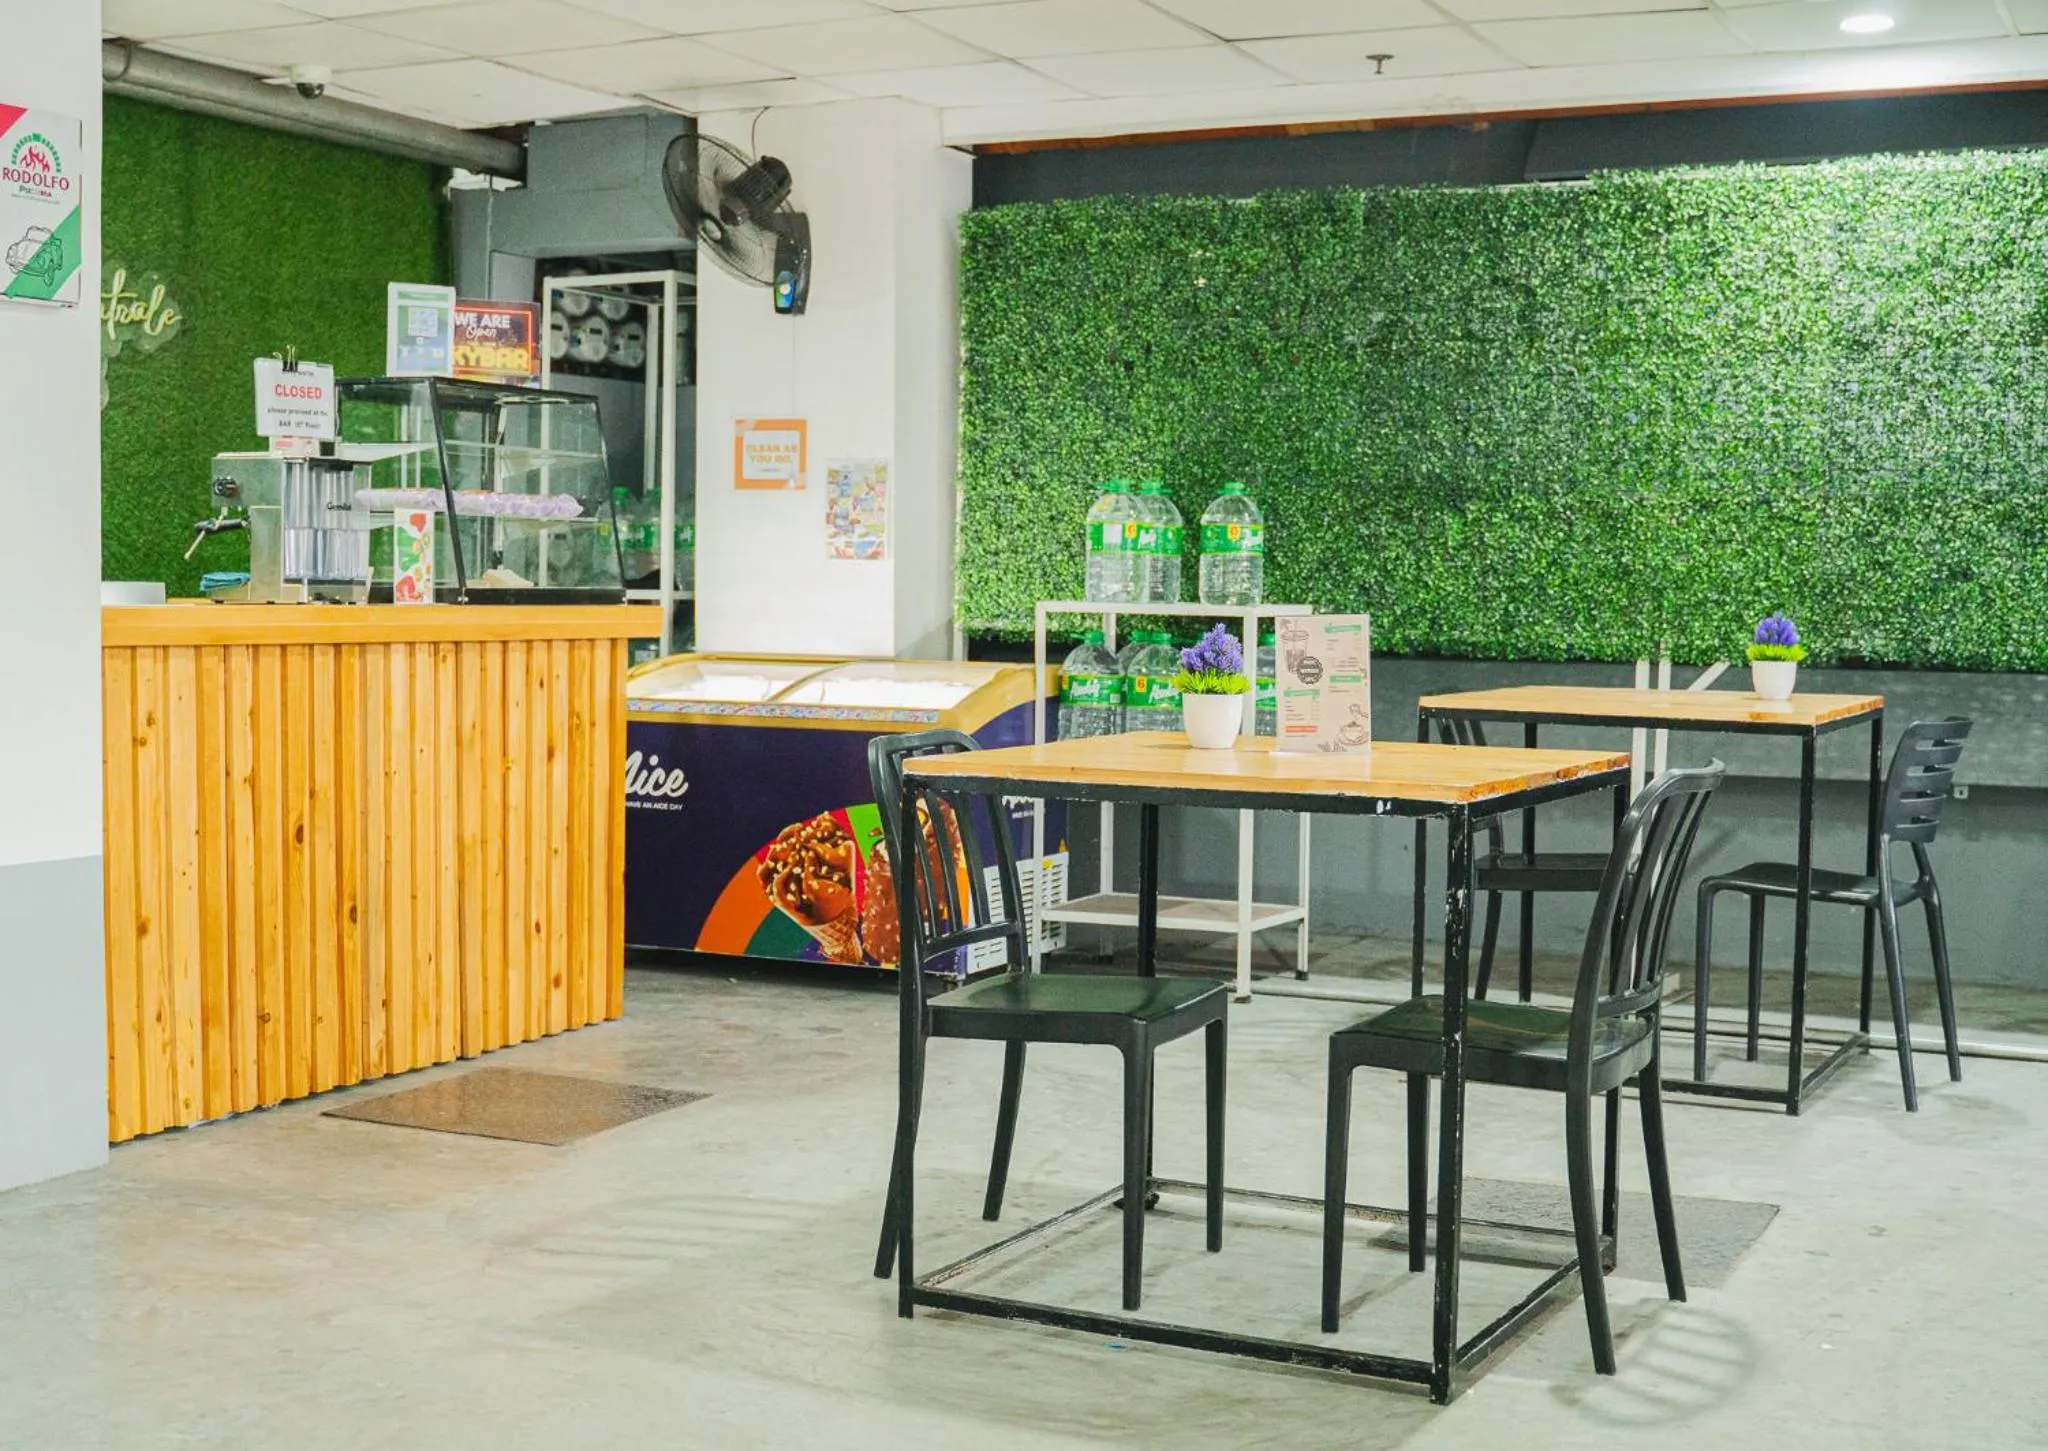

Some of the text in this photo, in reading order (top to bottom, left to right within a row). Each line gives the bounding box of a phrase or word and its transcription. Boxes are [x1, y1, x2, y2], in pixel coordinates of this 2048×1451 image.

[2, 167, 69, 191] RODOLFO
[455, 312, 512, 329] WE ARE
[466, 325, 497, 340] Open
[274, 383, 322, 399] CLOSED
[750, 454, 772, 463] YOU
[669, 803, 683, 812] DAY
